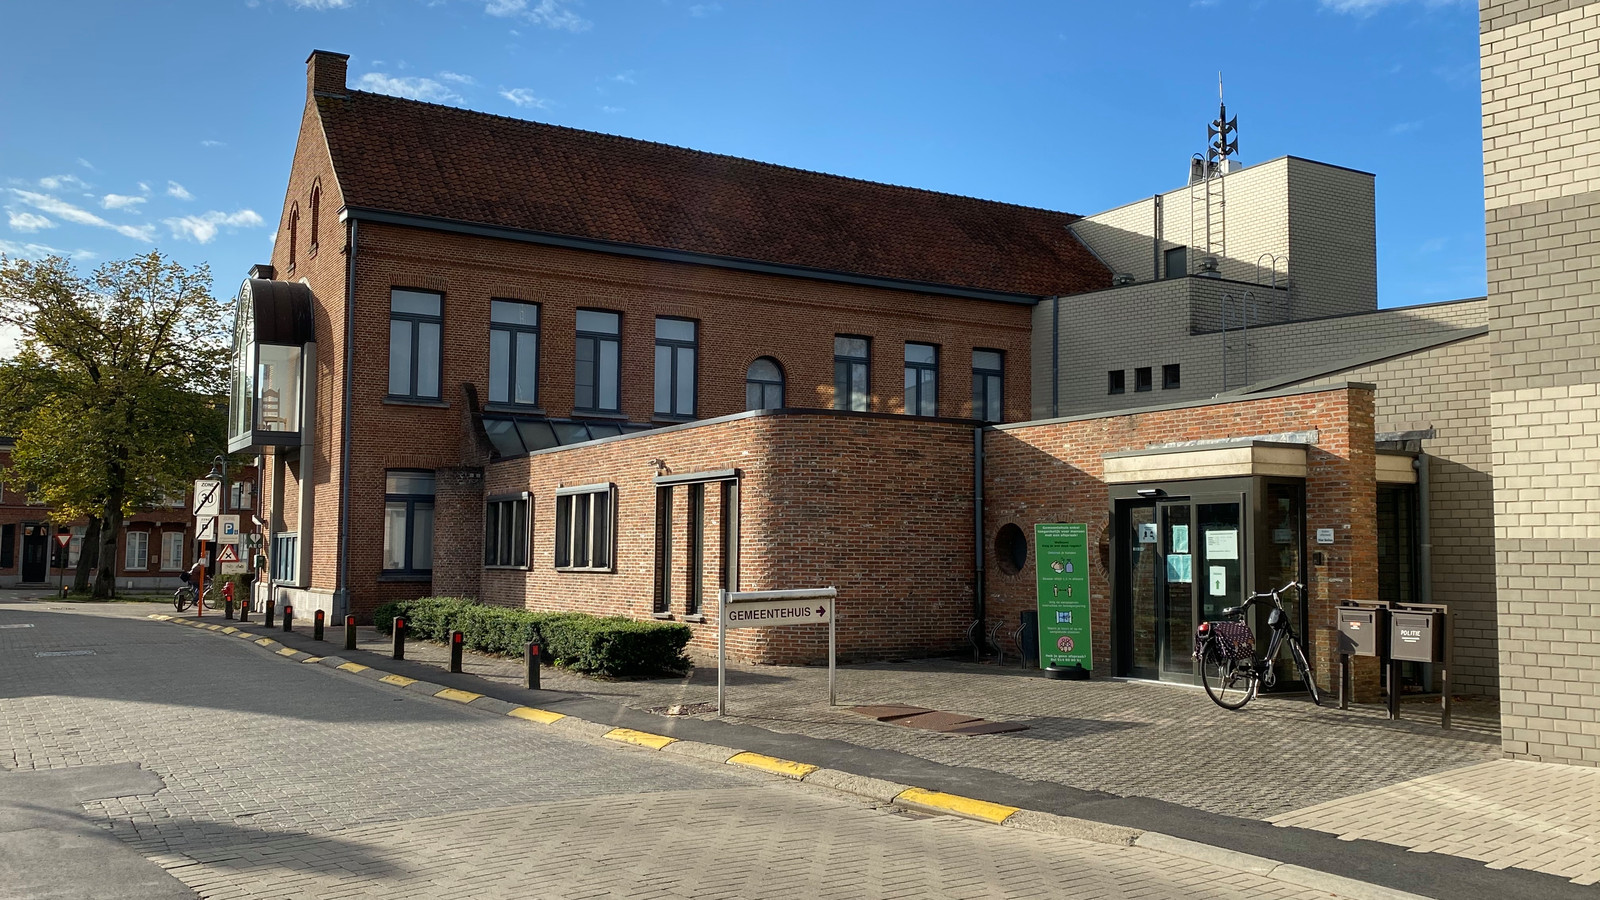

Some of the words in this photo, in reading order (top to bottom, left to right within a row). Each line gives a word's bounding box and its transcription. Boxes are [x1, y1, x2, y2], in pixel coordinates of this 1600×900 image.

[201, 493, 214, 504] 30
[225, 523, 233, 534] P
[729, 607, 811, 621] GEMEENTEHUIS
